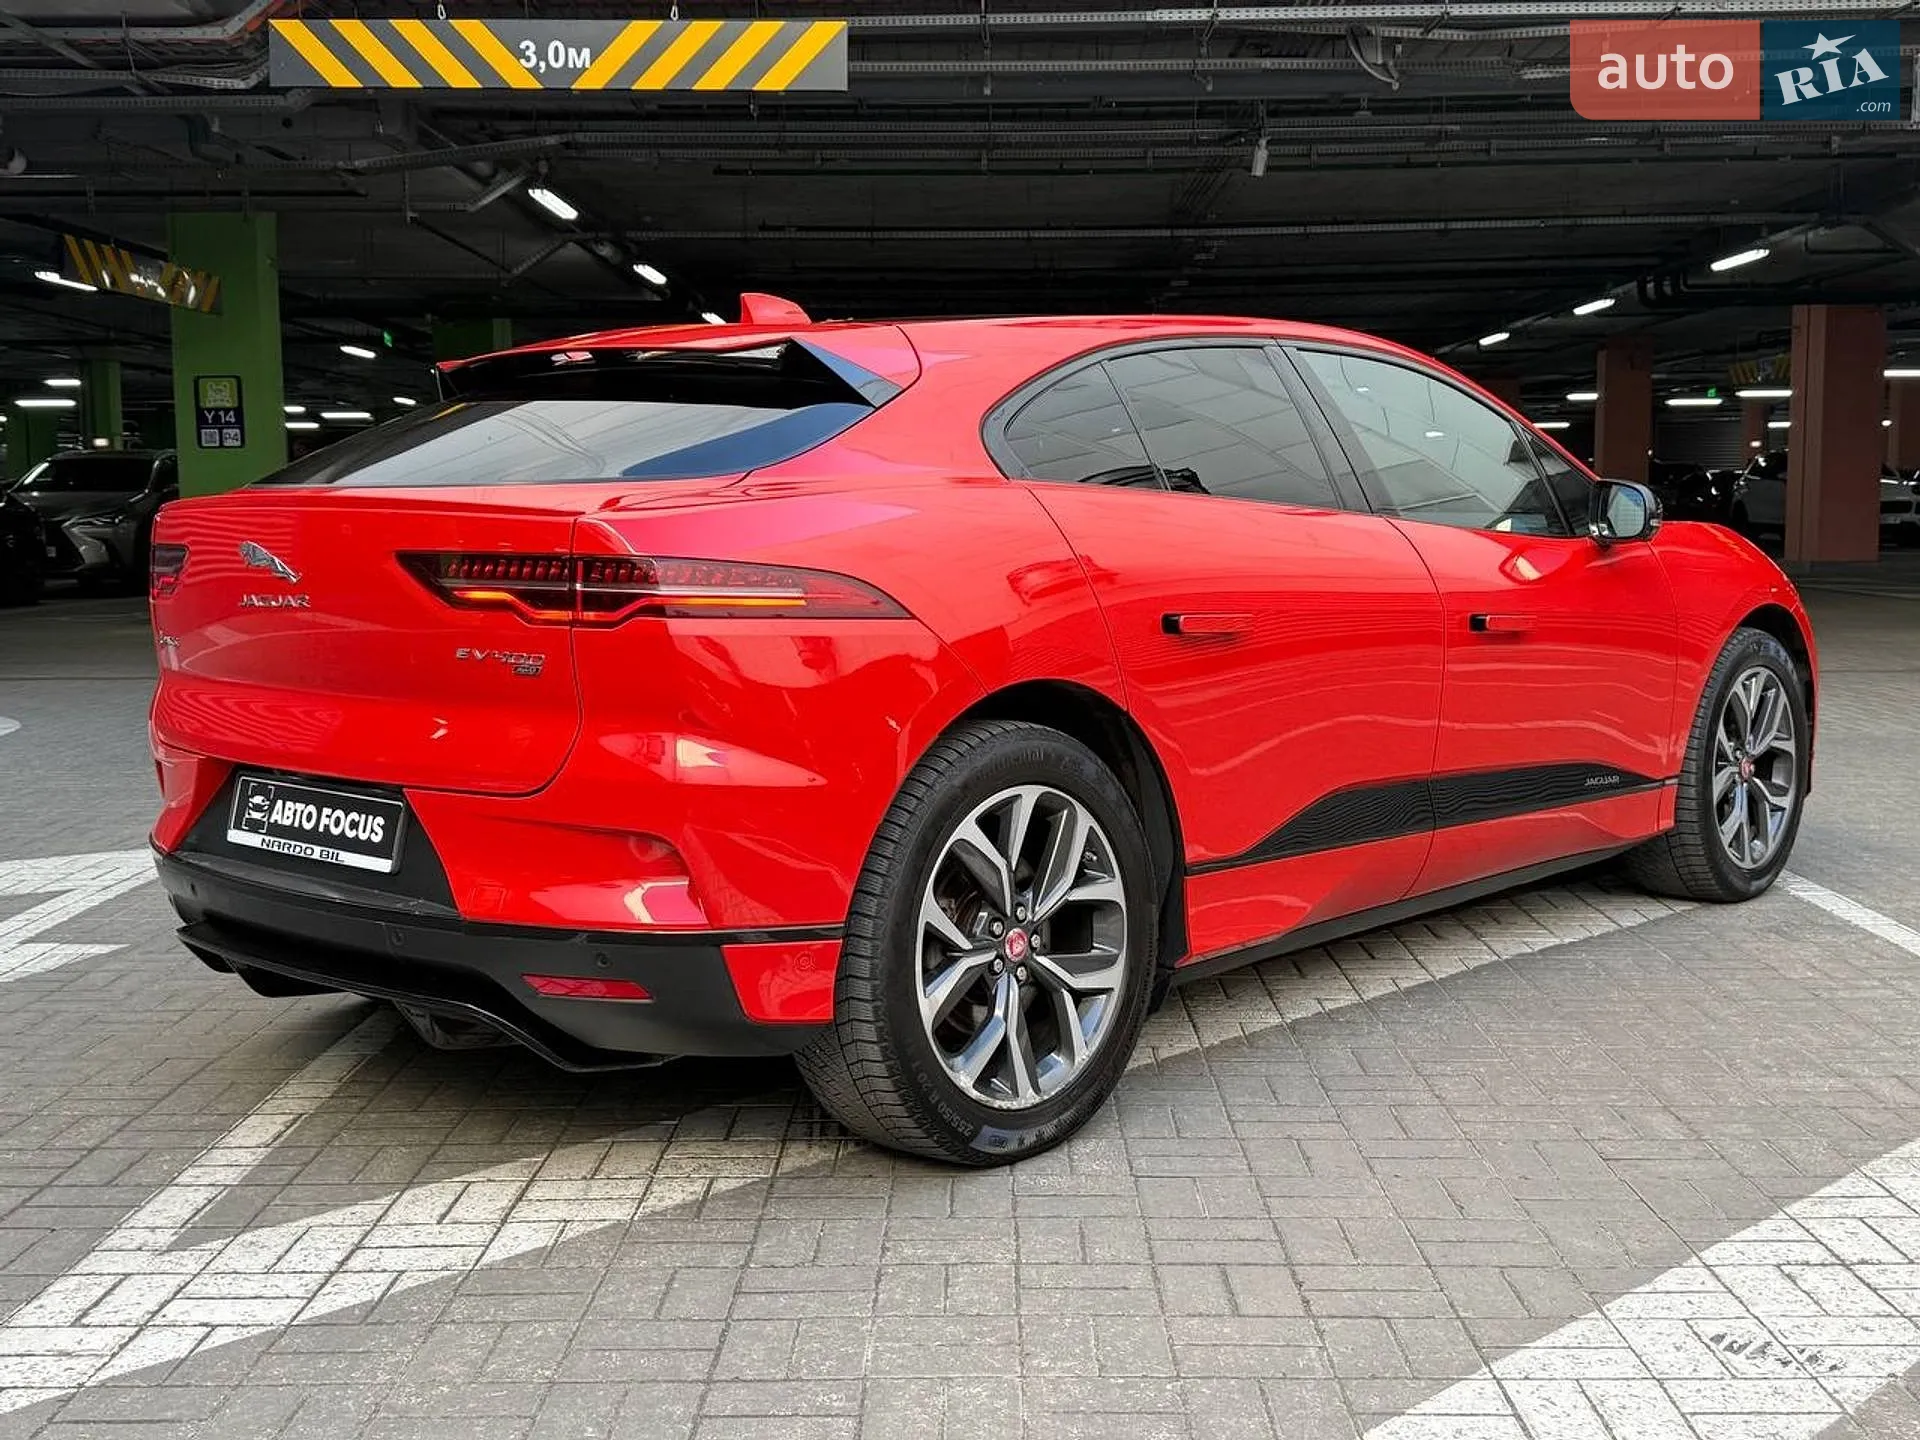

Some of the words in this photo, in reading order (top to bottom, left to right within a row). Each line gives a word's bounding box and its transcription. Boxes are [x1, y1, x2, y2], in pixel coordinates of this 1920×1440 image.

[519, 39, 591, 74] 3,0м
[204, 410, 215, 423] Y
[218, 410, 236, 423] 14
[238, 593, 311, 608] JAGUAR
[1584, 775, 1620, 786] JAGUAR
[318, 806, 385, 844] FOCUS
[260, 837, 315, 857] NARDO
[319, 850, 345, 864] BIL
